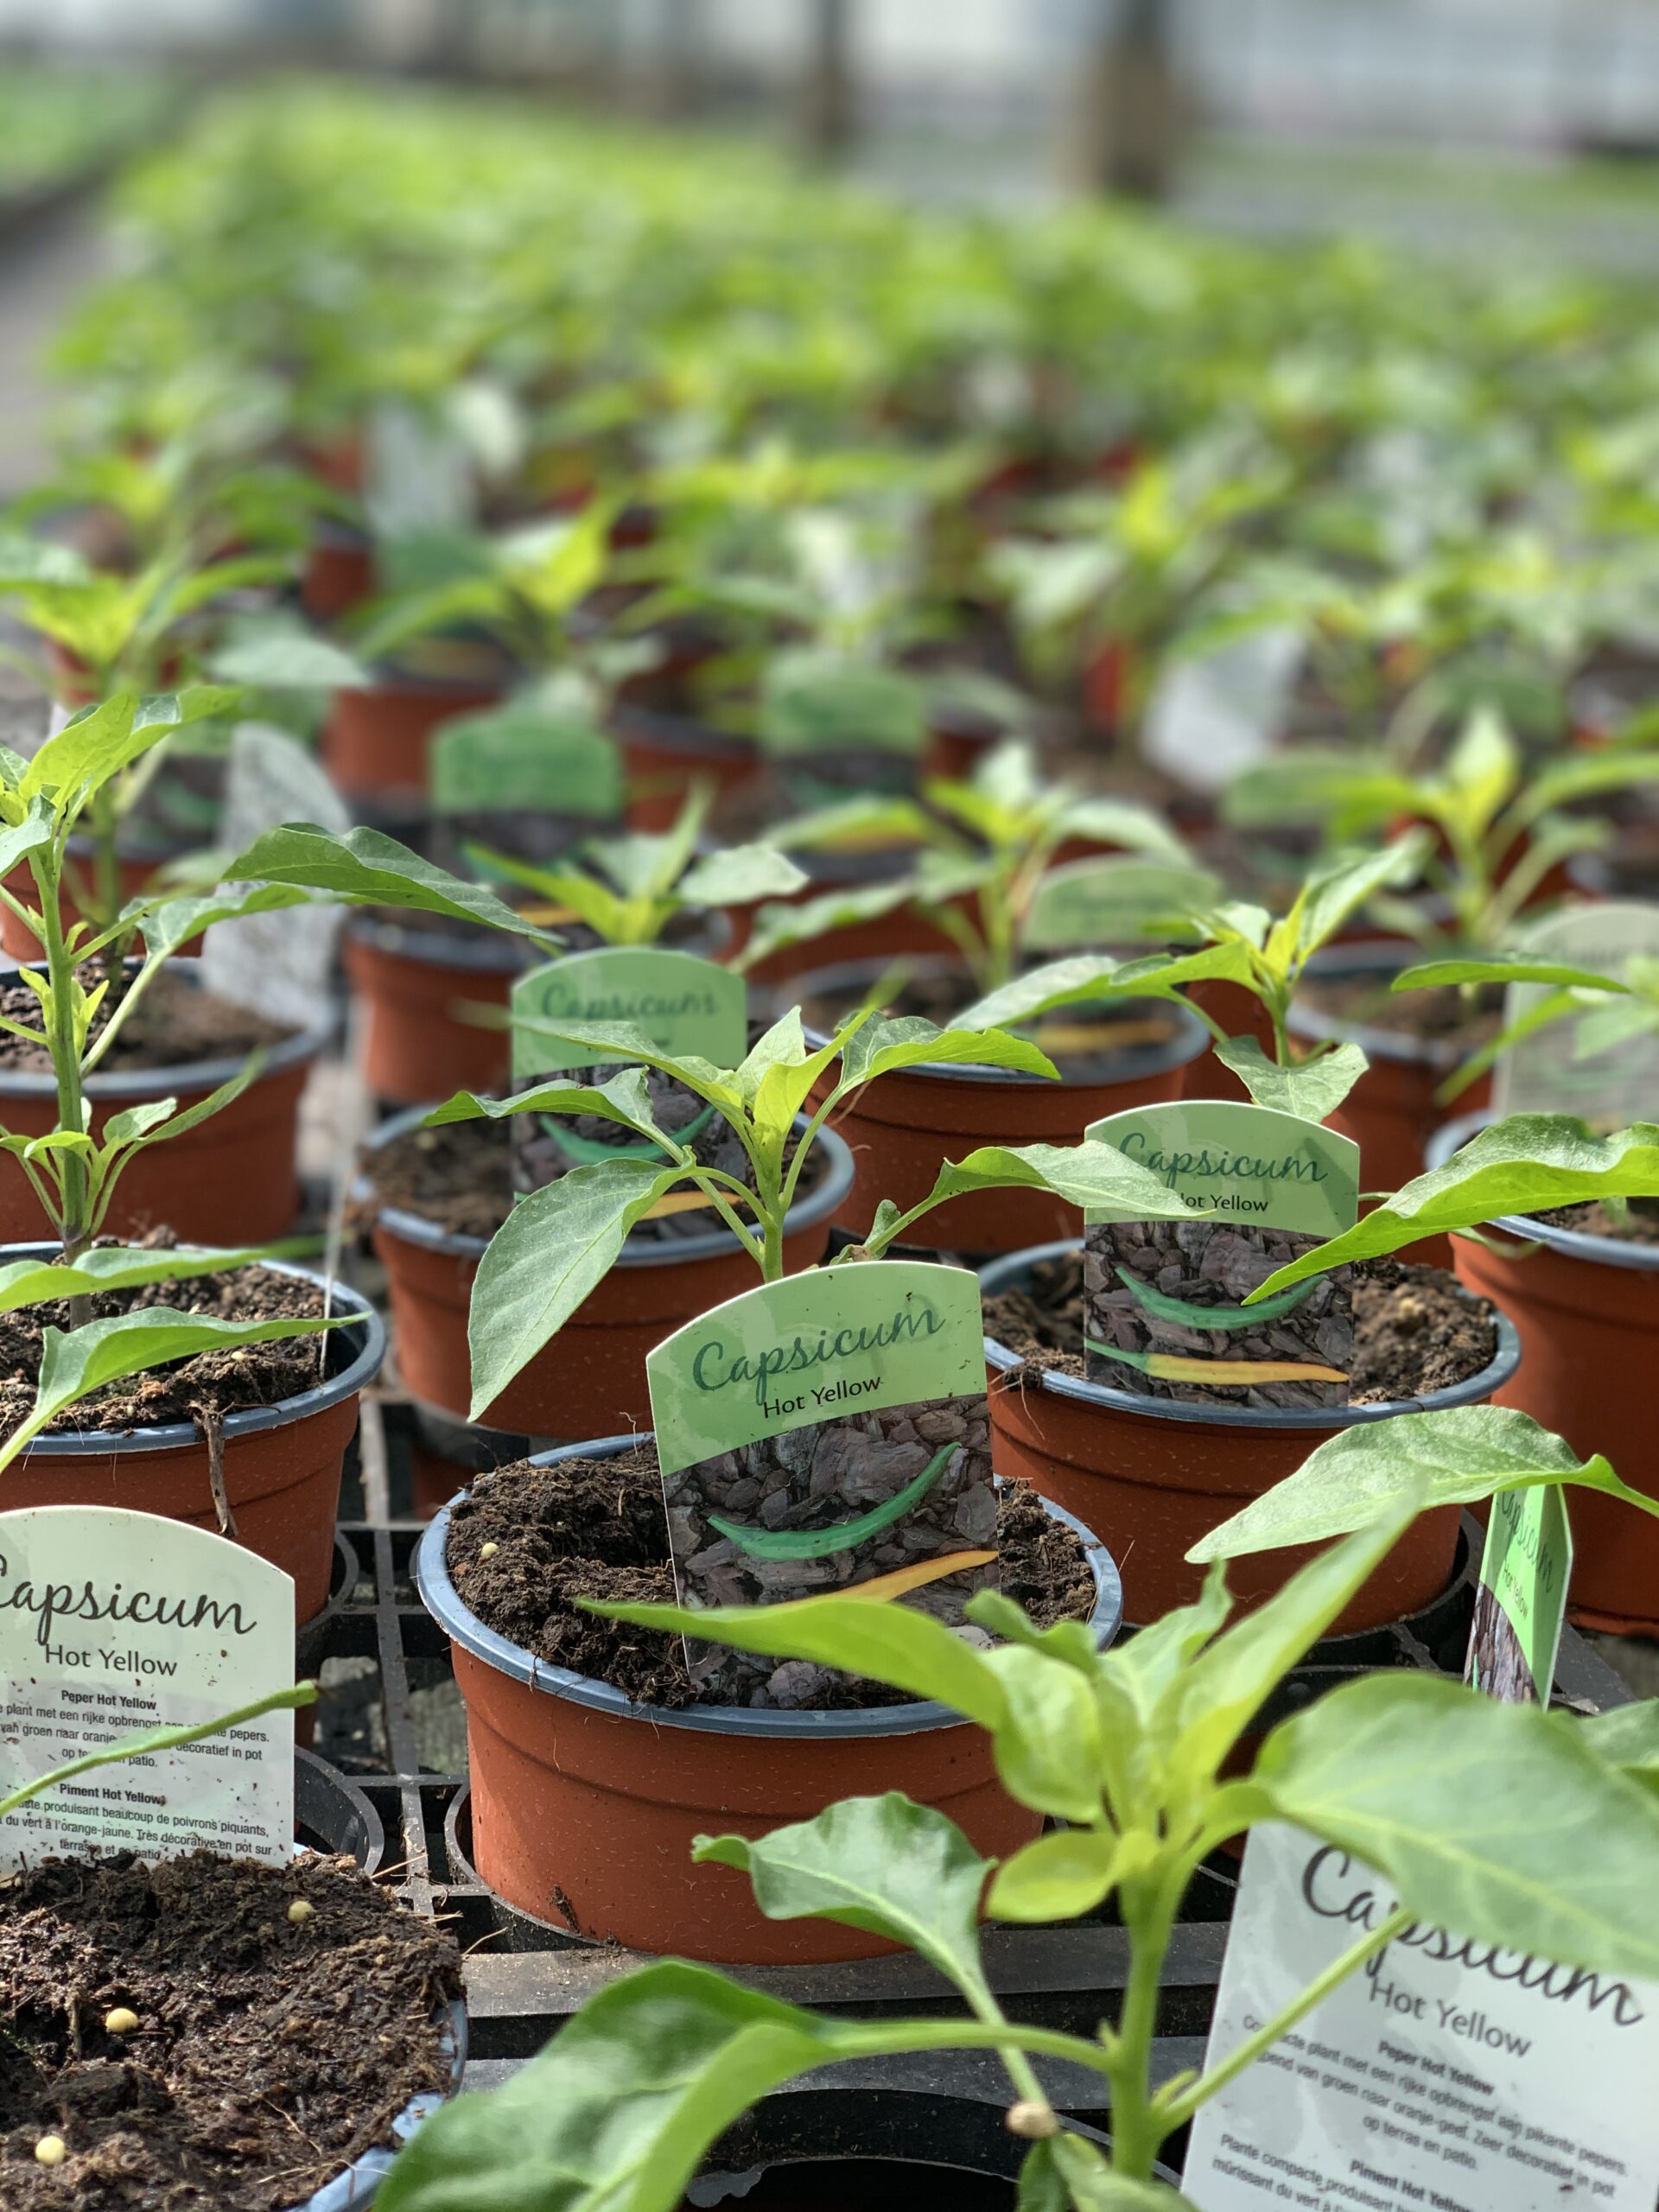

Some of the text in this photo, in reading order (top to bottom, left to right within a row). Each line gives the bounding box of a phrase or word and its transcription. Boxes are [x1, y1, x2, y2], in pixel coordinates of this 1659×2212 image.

[1211, 1194, 1268, 1213] Yellow
[693, 1308, 946, 1405] Capsicum
[764, 1374, 882, 1419] Hot Yellow
[45, 1643, 178, 1677] Hot Yellow
[7, 1703, 33, 1716] plant
[36, 1708, 56, 1719] met
[60, 1711, 79, 1721] een
[82, 1713, 105, 1725] rijke
[61, 1690, 156, 1710] Peper Hot Yellow
[1, 1724, 19, 1733] van
[22, 1726, 53, 1737] groen
[56, 1729, 79, 1739] naar
[231, 1729, 270, 1743] pepers.
[61, 1748, 75, 1759] op
[232, 1746, 242, 1758] in
[245, 1750, 263, 1761] pot
[60, 1783, 162, 1805] Piment Hot Yellow
[44, 1802, 99, 1817] produisant
[102, 1808, 154, 1823] beaucoup
[157, 1814, 169, 1825] de
[173, 1816, 217, 1830] poivrons
[220, 1822, 269, 1838] piquants,
[6, 1815, 19, 1826] du
[22, 1819, 42, 1829] vert
[137, 1828, 158, 1842] Très
[219, 1841, 232, 1850] en
[235, 1842, 252, 1853] pot
[255, 1846, 272, 1856] sur
[105, 1845, 116, 1855] et
[1370, 1978, 1532, 2057] Hot Yellow
[1378, 2040, 1495, 2095] Peper Hot Yellow
[1220, 2133, 1260, 2160] Plante
[1262, 2152, 1323, 2187] compacte
[1350, 2158, 1474, 2212] Piment Hot Yello
